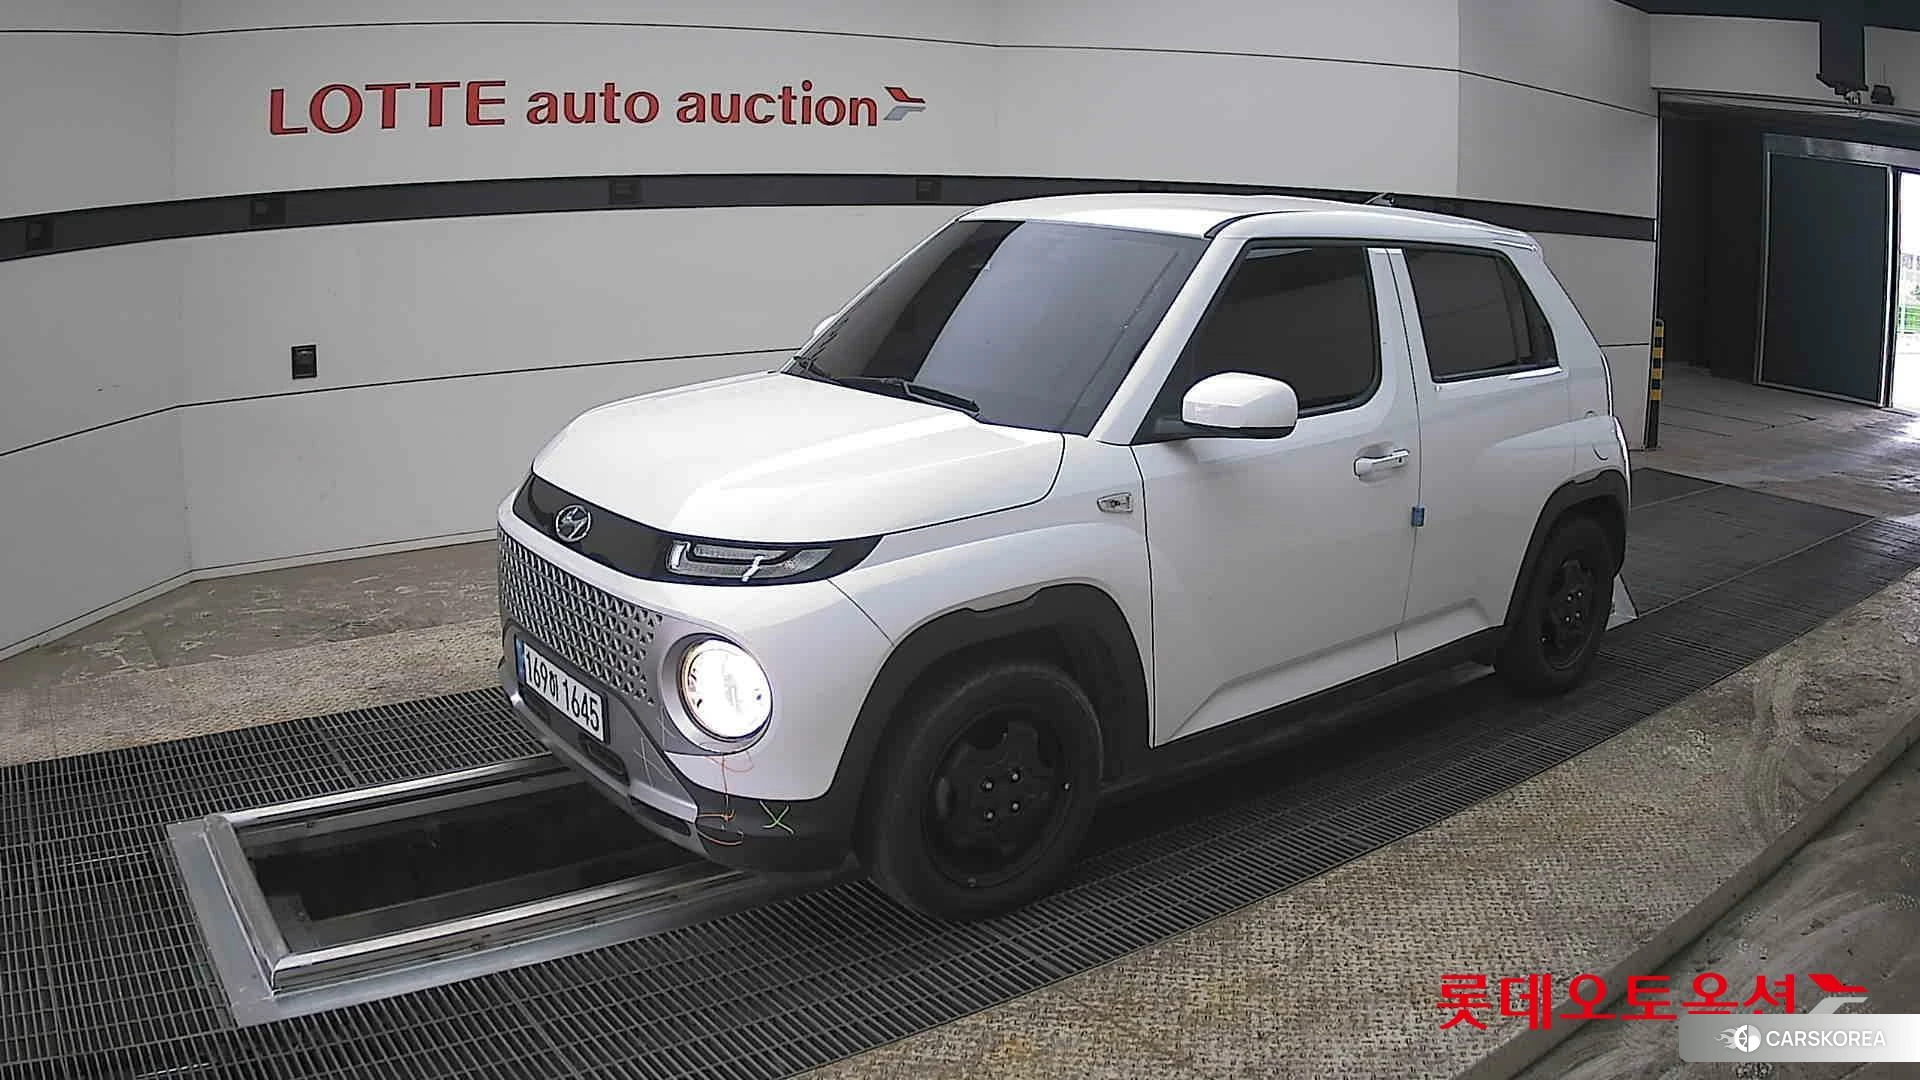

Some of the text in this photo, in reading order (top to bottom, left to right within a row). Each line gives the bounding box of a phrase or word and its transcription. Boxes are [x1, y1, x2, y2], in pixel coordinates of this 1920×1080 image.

[268, 80, 879, 136] LOTTE auto auction
